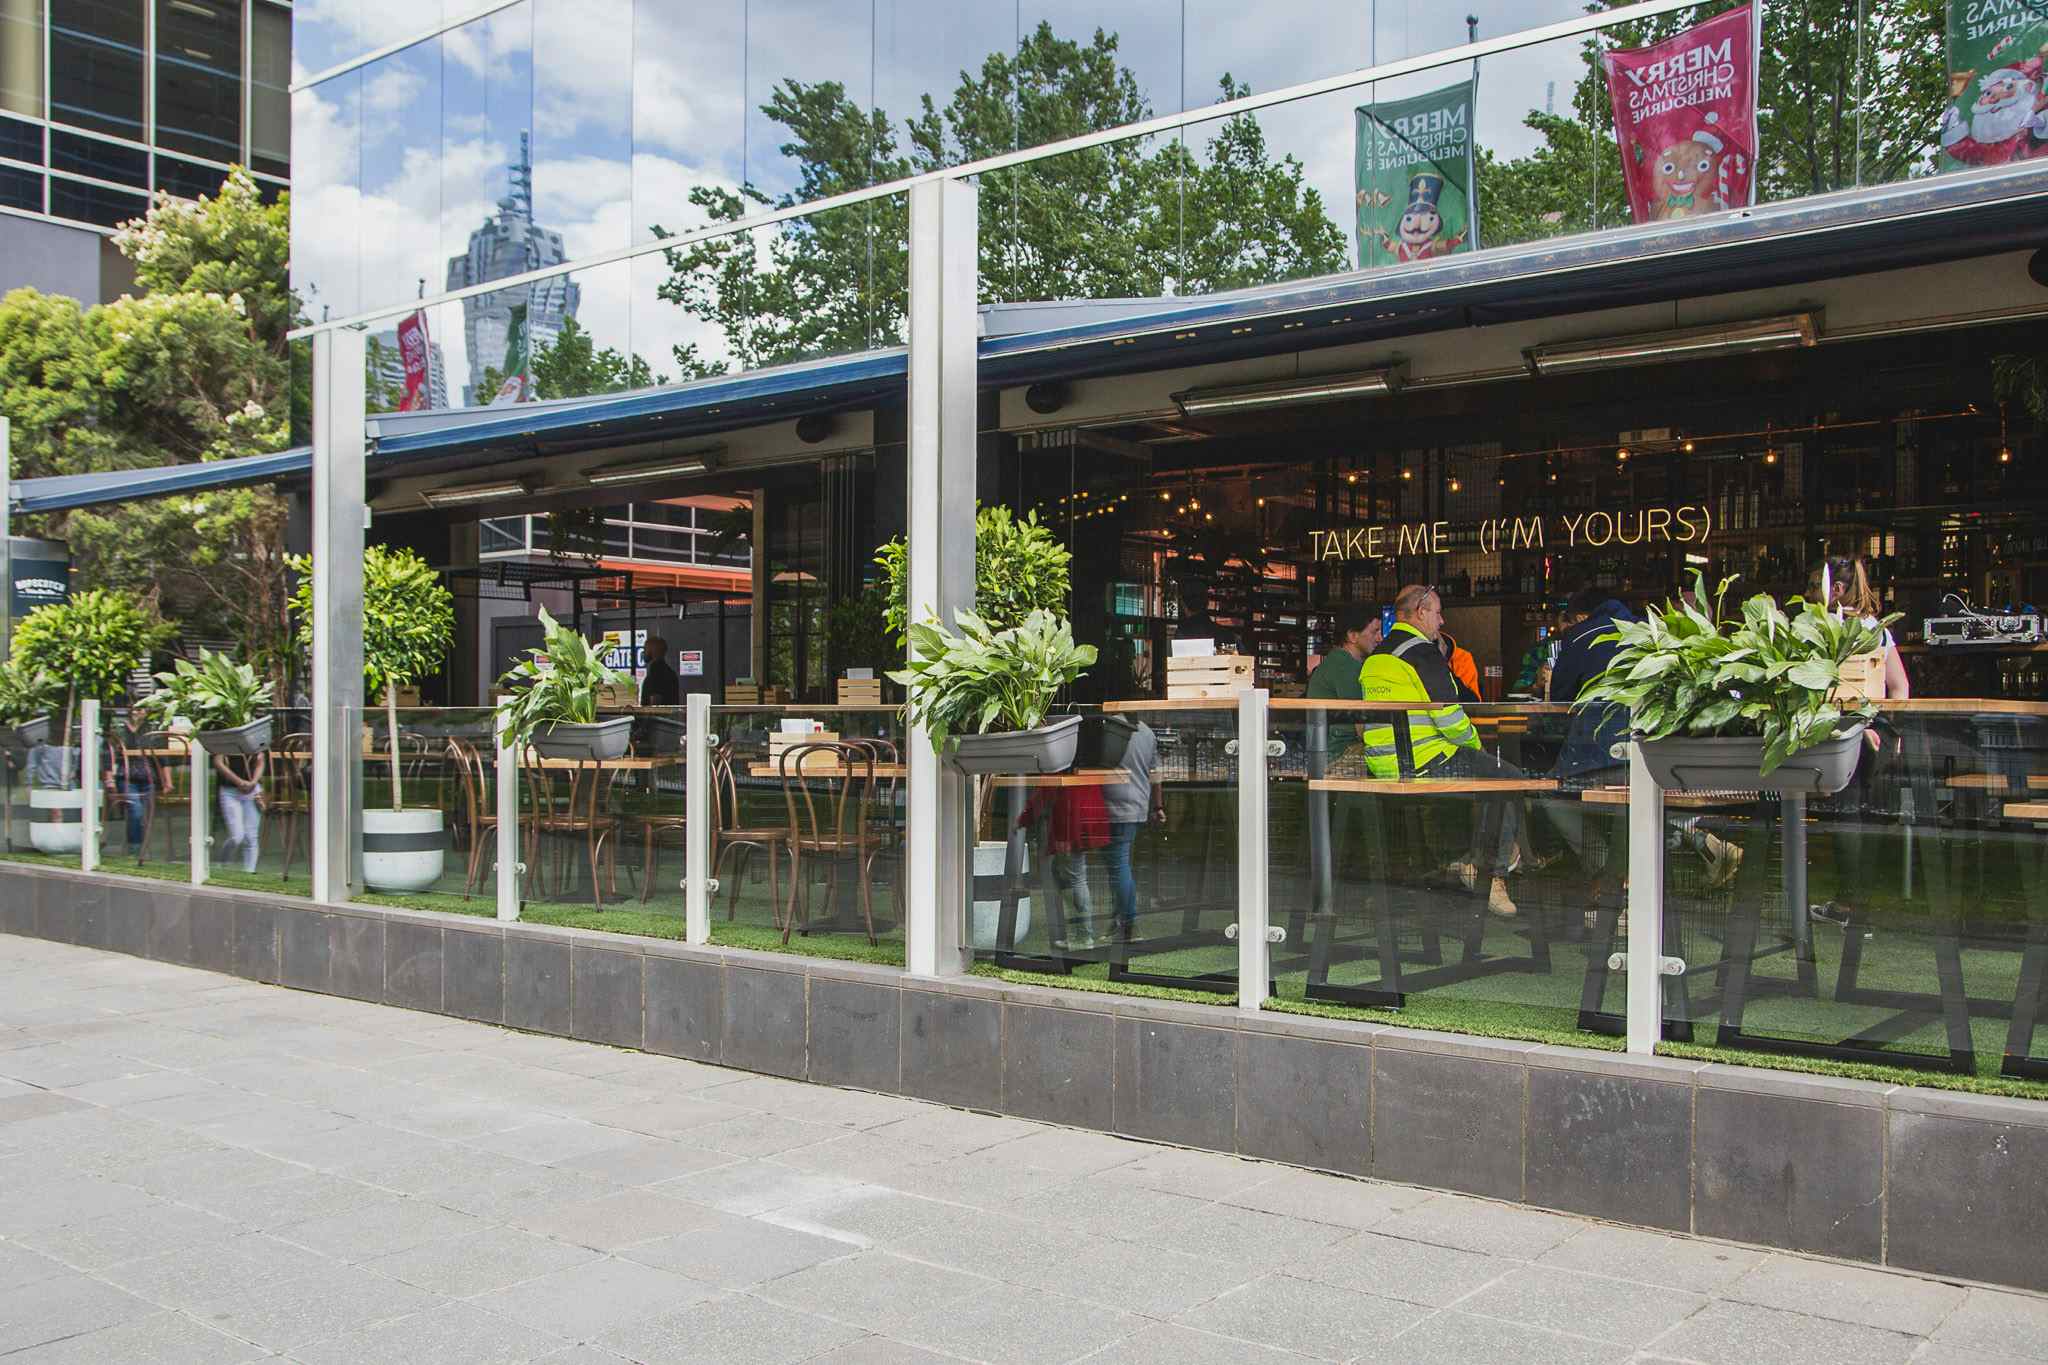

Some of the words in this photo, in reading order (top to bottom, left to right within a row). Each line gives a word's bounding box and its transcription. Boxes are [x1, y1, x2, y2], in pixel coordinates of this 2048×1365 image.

[1308, 526, 1385, 561] TAKE
[1398, 521, 1451, 556] ME
[1480, 515, 1544, 555] (I'M
[1562, 505, 1711, 548] YOURS)
[605, 648, 632, 668] GATE
